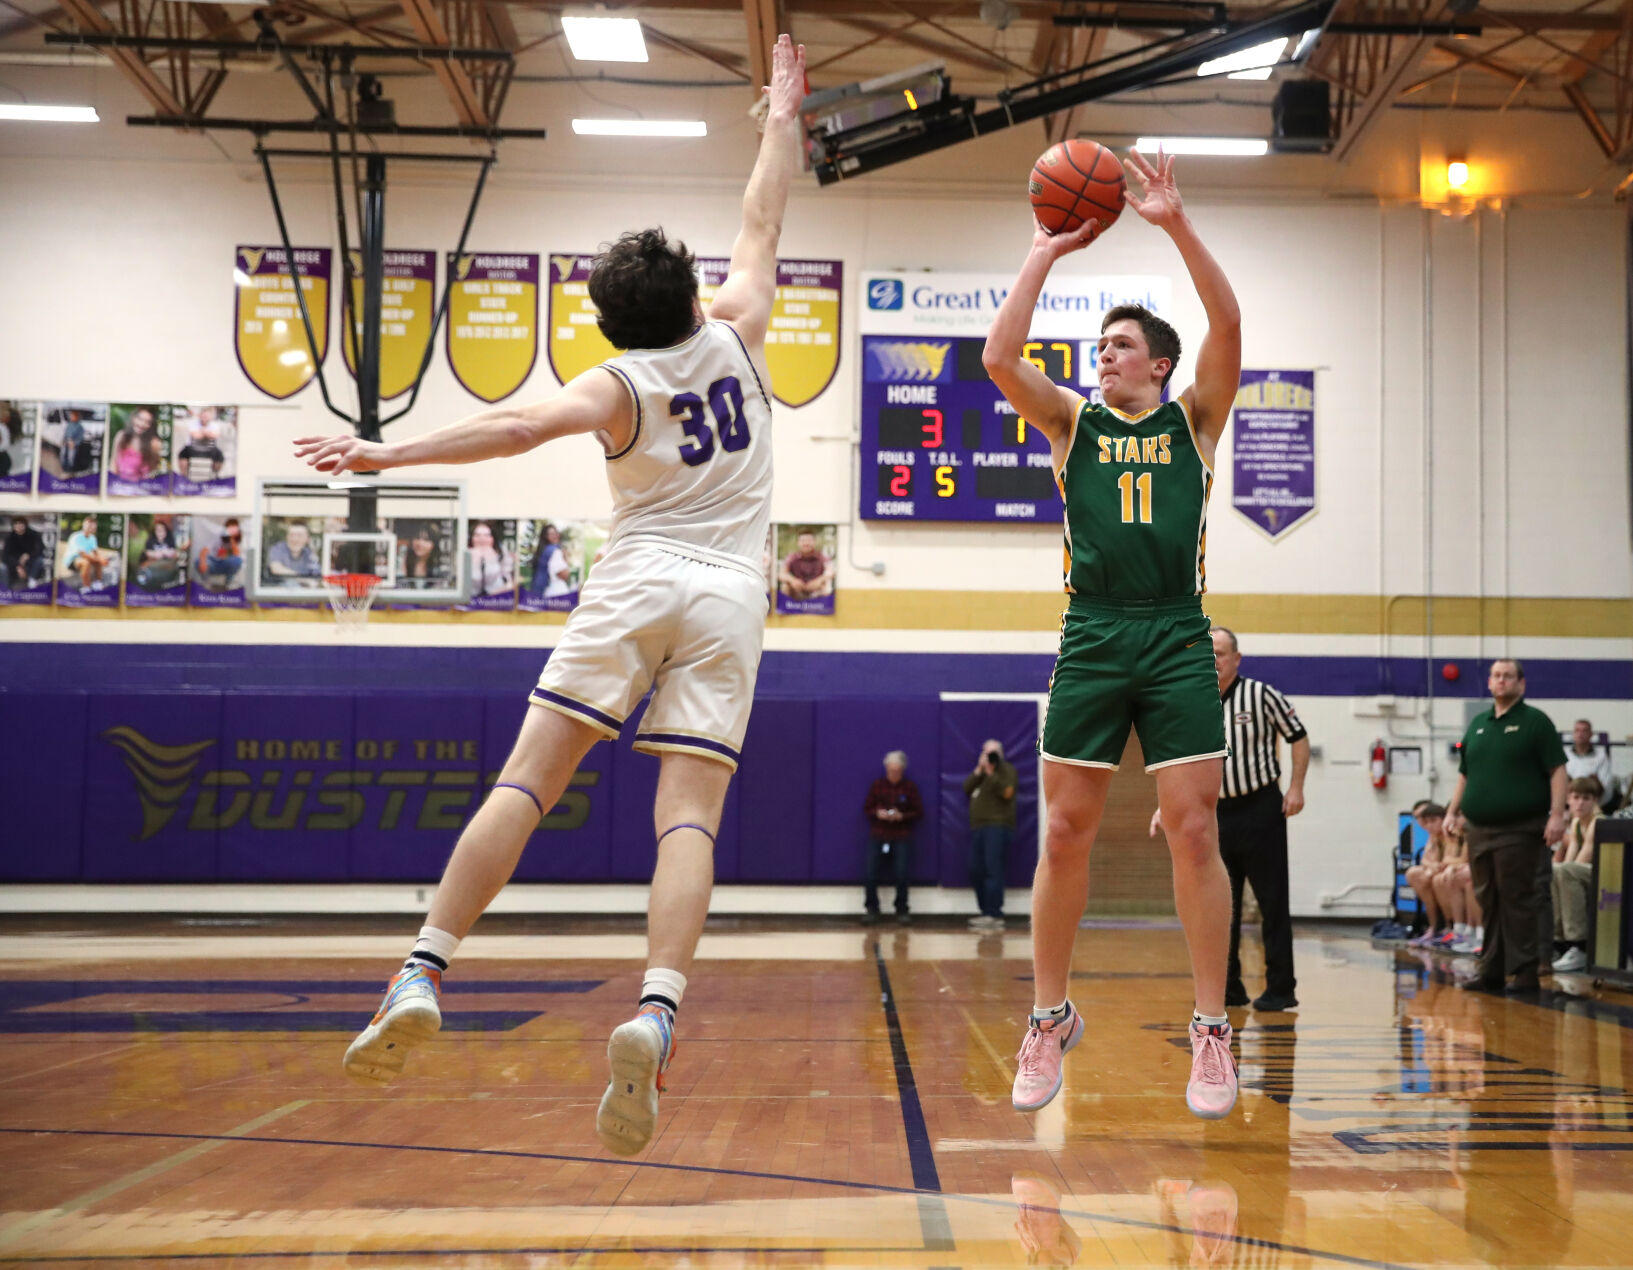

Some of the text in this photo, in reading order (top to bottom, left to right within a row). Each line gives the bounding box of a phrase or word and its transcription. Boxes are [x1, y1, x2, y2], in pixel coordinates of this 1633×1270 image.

[912, 286, 981, 310] Great
[887, 385, 937, 404] HOME
[668, 375, 752, 467] 30
[921, 409, 943, 448] 3
[1017, 417, 1026, 443] 1
[877, 451, 915, 465] FOULS
[972, 453, 1018, 467] PLAYER
[1098, 433, 1171, 464] STARS
[890, 465, 955, 497] 2 5
[876, 501, 1035, 517] SCORE MATCH
[1118, 471, 1152, 524] 11
[236, 739, 478, 760] HOME OF THE
[186, 769, 600, 831] DUSTES
